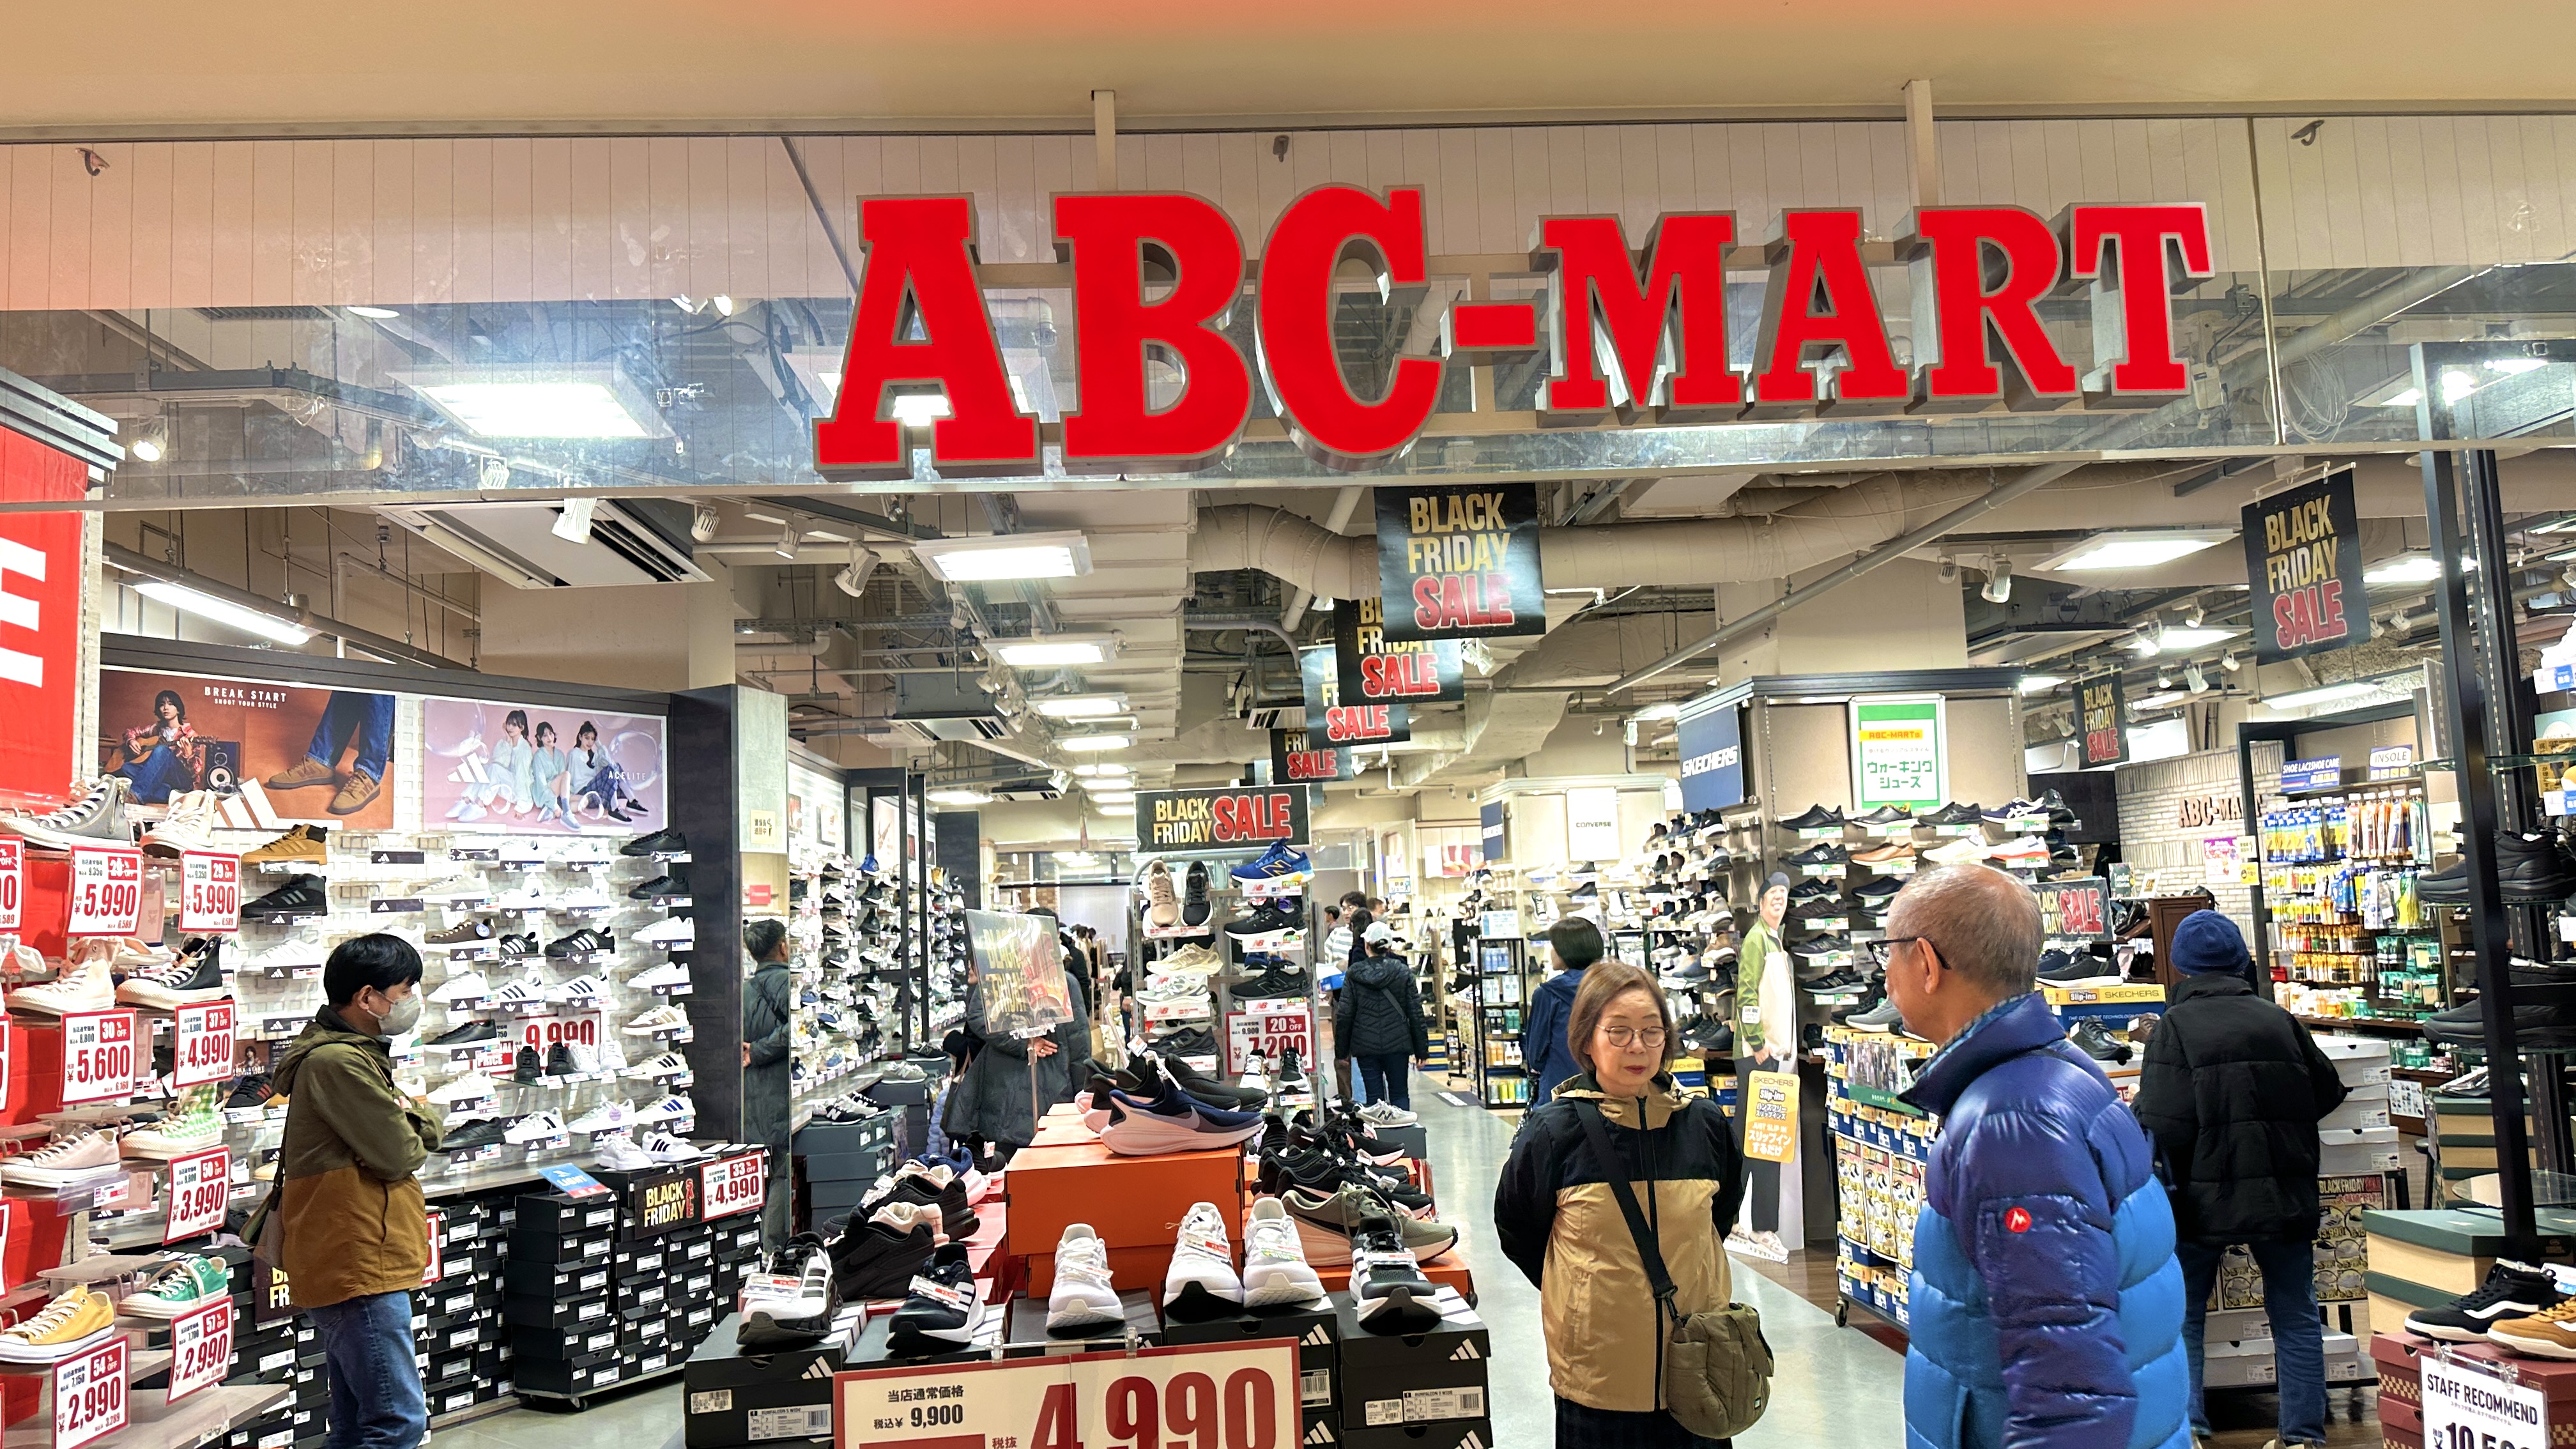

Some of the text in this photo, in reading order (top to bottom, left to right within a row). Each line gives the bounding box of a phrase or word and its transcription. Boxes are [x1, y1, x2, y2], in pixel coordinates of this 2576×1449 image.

[815, 184, 2212, 470] ABC-MART
[1409, 493, 1506, 534] BLACK
[2265, 494, 2333, 554] BLACK
[1406, 533, 1510, 574] FRIDAY
[2266, 536, 2338, 594] FRIDAY
[1413, 574, 1515, 629] SALE
[2272, 579, 2348, 650] SALE
[1361, 654, 1440, 697] SALE
[204, 686, 286, 702] BREAK START
[2083, 683, 2113, 708] BLACK
[1326, 704, 1391, 742] SALE
[2084, 703, 2116, 732] FRIDAY
[2087, 727, 2119, 763] SALE
[2375, 751, 2407, 763] INSOLE
[1287, 750, 1338, 779] SALE
[1682, 745, 1738, 778] SKECHERS
[1867, 760, 1933, 773] ウォーキング
[2283, 763, 2297, 774] SHOE
[2326, 758, 2340, 769] CARE
[608, 770, 646, 781] ACELITE
[1880, 776, 1921, 788] シューズ
[1154, 797, 1210, 822] BLACK
[1213, 793, 1293, 842] SALE
[2179, 794, 2262, 828] ABC-MAT
[1153, 820, 1213, 845] FRIDAY
[213, 862, 224, 878] 29
[84, 884, 137, 919] 5,990
[193, 884, 235, 916] 5,990
[2038, 887, 2104, 935] LACK SALE
[2044, 913, 2061, 934] IDAY
[2069, 990, 2160, 1002] Slip-ins SKECHERS
[102, 1021, 115, 1039] 30
[209, 1012, 218, 1029] 37
[1270, 1018, 1287, 1032] 20
[117, 1029, 126, 1038] OFF
[187, 1033, 230, 1070] 4,990
[1248, 1034, 1307, 1059] 7200
[77, 1045, 130, 1085] 5,600
[1754, 1077, 1794, 1086] SKECHERS
[1748, 1130, 1791, 1146] スリップイン
[1767, 1124, 1780, 1132] SLIP
[1752, 1142, 1784, 1157] するだけ
[203, 1161, 213, 1179] 50
[556, 1174, 588, 1186] LIGHT
[732, 1162, 746, 1177] 33
[646, 1178, 694, 1218] BLACK SALE
[716, 1175, 760, 1206] 4,990
[2319, 1179, 2341, 1194] BLACK
[2341, 1177, 2364, 1193] FRIDAY
[180, 1181, 225, 1222] 3,990
[643, 1199, 686, 1228] FRIDAY
[206, 1314, 215, 1333] 57
[93, 1356, 105, 1377] 54
[107, 1360, 118, 1371] OFF
[183, 1333, 227, 1380] 2,990
[68, 1376, 121, 1432] 2,990
[887, 1384, 964, 1403] 当店通常価格
[2427, 1374, 2538, 1425] STAFF RECOMMEND
[910, 1404, 963, 1429] 9,900
[1031, 1367, 1276, 1449] 4990
